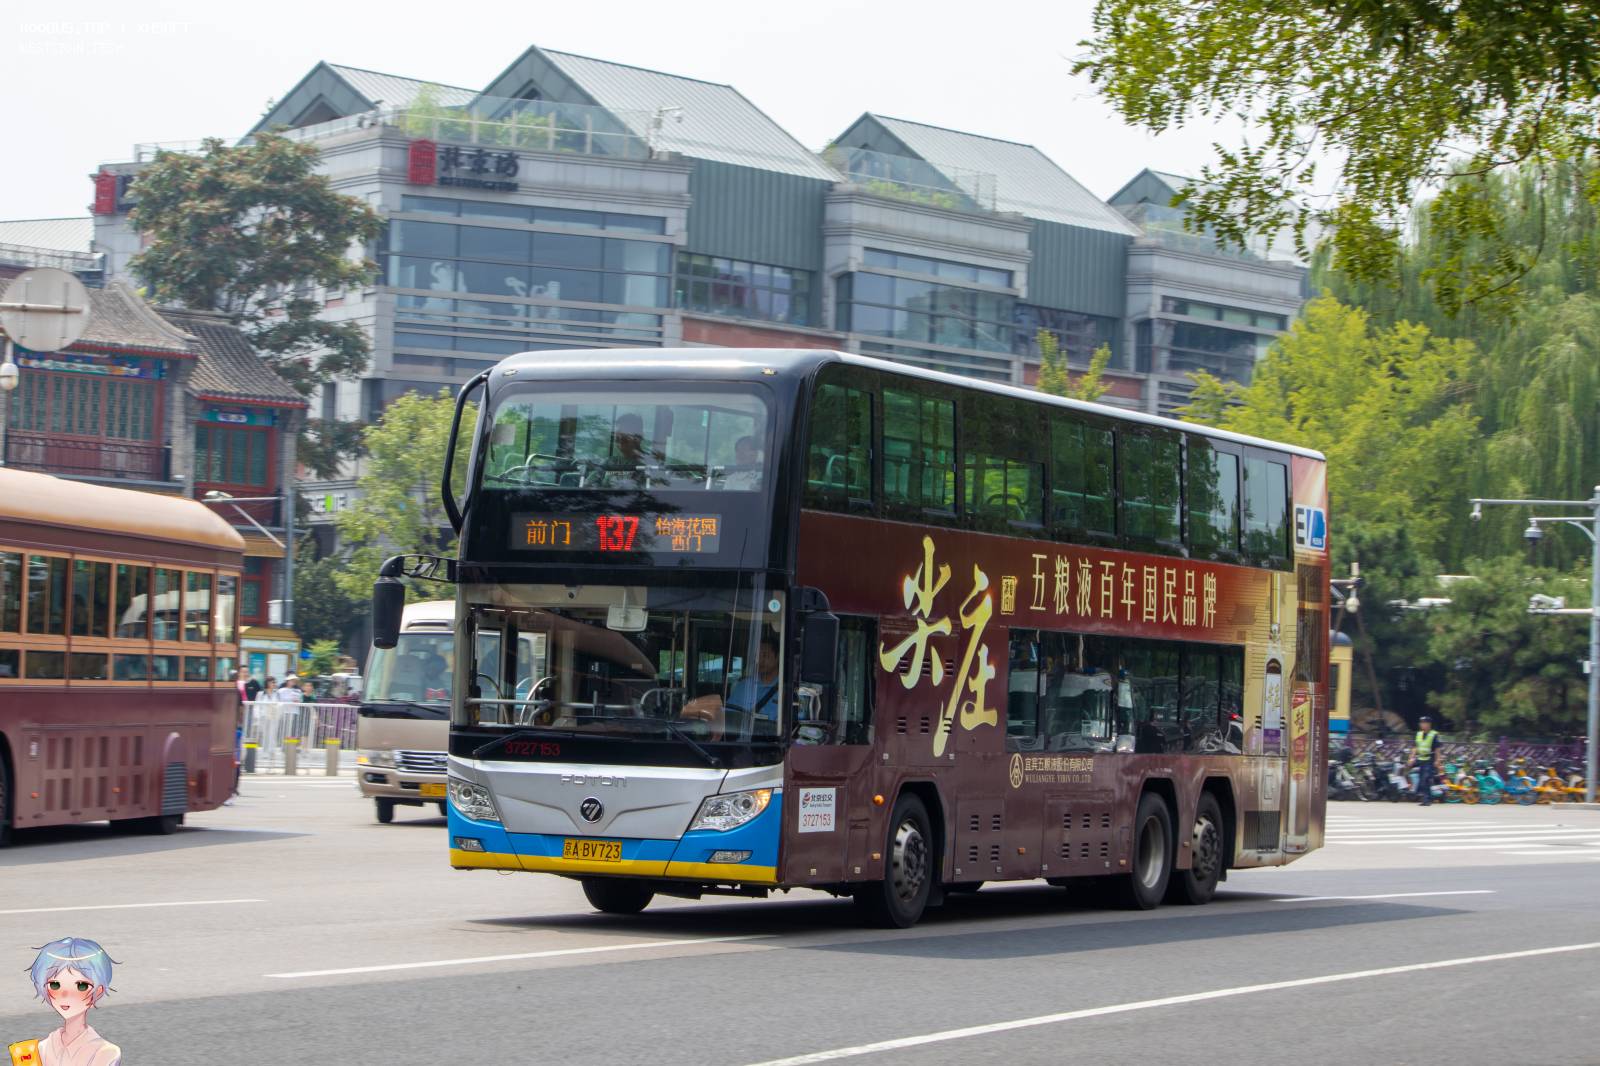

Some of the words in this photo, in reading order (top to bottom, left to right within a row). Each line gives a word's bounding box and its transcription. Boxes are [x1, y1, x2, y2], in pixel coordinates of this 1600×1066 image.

[526, 519, 571, 545] 前门
[595, 515, 640, 553] 137
[656, 517, 717, 536] 怡海花园
[672, 535, 702, 552] 西门
[1029, 553, 1218, 629] 五粮液百年国民品牌
[505, 742, 561, 756] 3727153
[802, 813, 832, 827] 3727153
